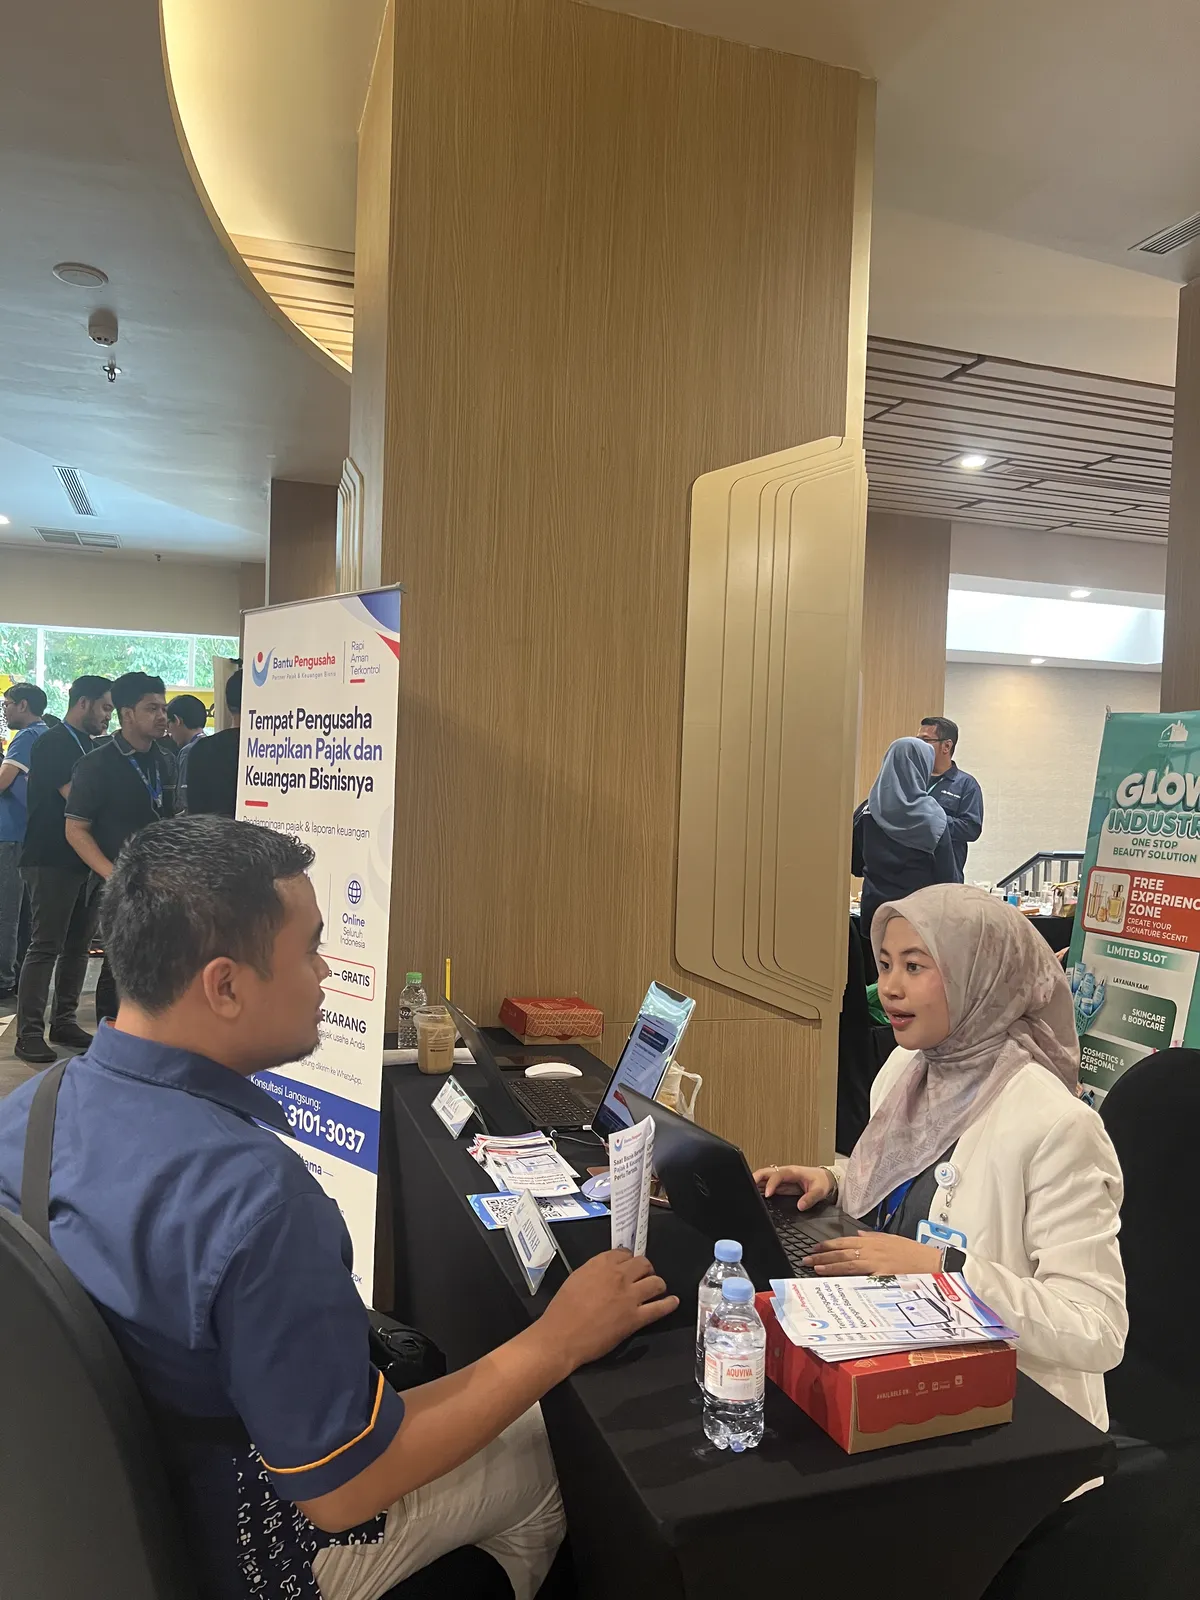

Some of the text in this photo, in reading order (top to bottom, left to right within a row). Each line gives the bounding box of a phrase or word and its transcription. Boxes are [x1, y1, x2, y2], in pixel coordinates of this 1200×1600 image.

[351, 640, 365, 653] Rapi
[272, 652, 336, 670] Bantu Pengusaha
[350, 653, 369, 663] Aman
[350, 664, 381, 675] Terkontrol
[249, 709, 293, 736] Tempat
[296, 706, 372, 736] Pengusaha
[247, 737, 383, 766] Merapikan Pajak dan
[245, 765, 374, 799] Keuangan Bisnisnya
[286, 820, 304, 834] pajak
[304, 821, 311, 832] &
[312, 821, 336, 836] laporan
[336, 823, 370, 841] keuangan
[1131, 837, 1178, 849] ONE STOP
[1112, 847, 1198, 863] BEAUTY SOLUTION
[1133, 876, 1165, 891] FREE
[1131, 889, 1200, 911] EXPERIENC
[1129, 903, 1162, 918] ZONE
[342, 912, 365, 927] Online
[1127, 917, 1172, 931] CREATE YOUR
[342, 926, 363, 939] Seluruh
[1126, 926, 1188, 943] SIGNATURE SCENT!
[340, 935, 366, 949] Indonesia
[1106, 944, 1168, 965] LIMITED SLOT
[341, 970, 370, 987] GRATIS
[1112, 976, 1149, 991] LAYANAN KAMI
[321, 1008, 367, 1034] EKARANG
[1121, 1013, 1165, 1032] & BODYCARE
[1131, 1008, 1166, 1024] SKINCARE
[350, 1037, 366, 1050] Anda
[1081, 1054, 1116, 1072] PERSONAL
[1082, 1046, 1125, 1066] COSMETICS &
[1080, 1061, 1098, 1073] CARE
[250, 1075, 321, 1112] Konsultasi Langsung:
[726, 1368, 753, 1378] AQUVIVA
